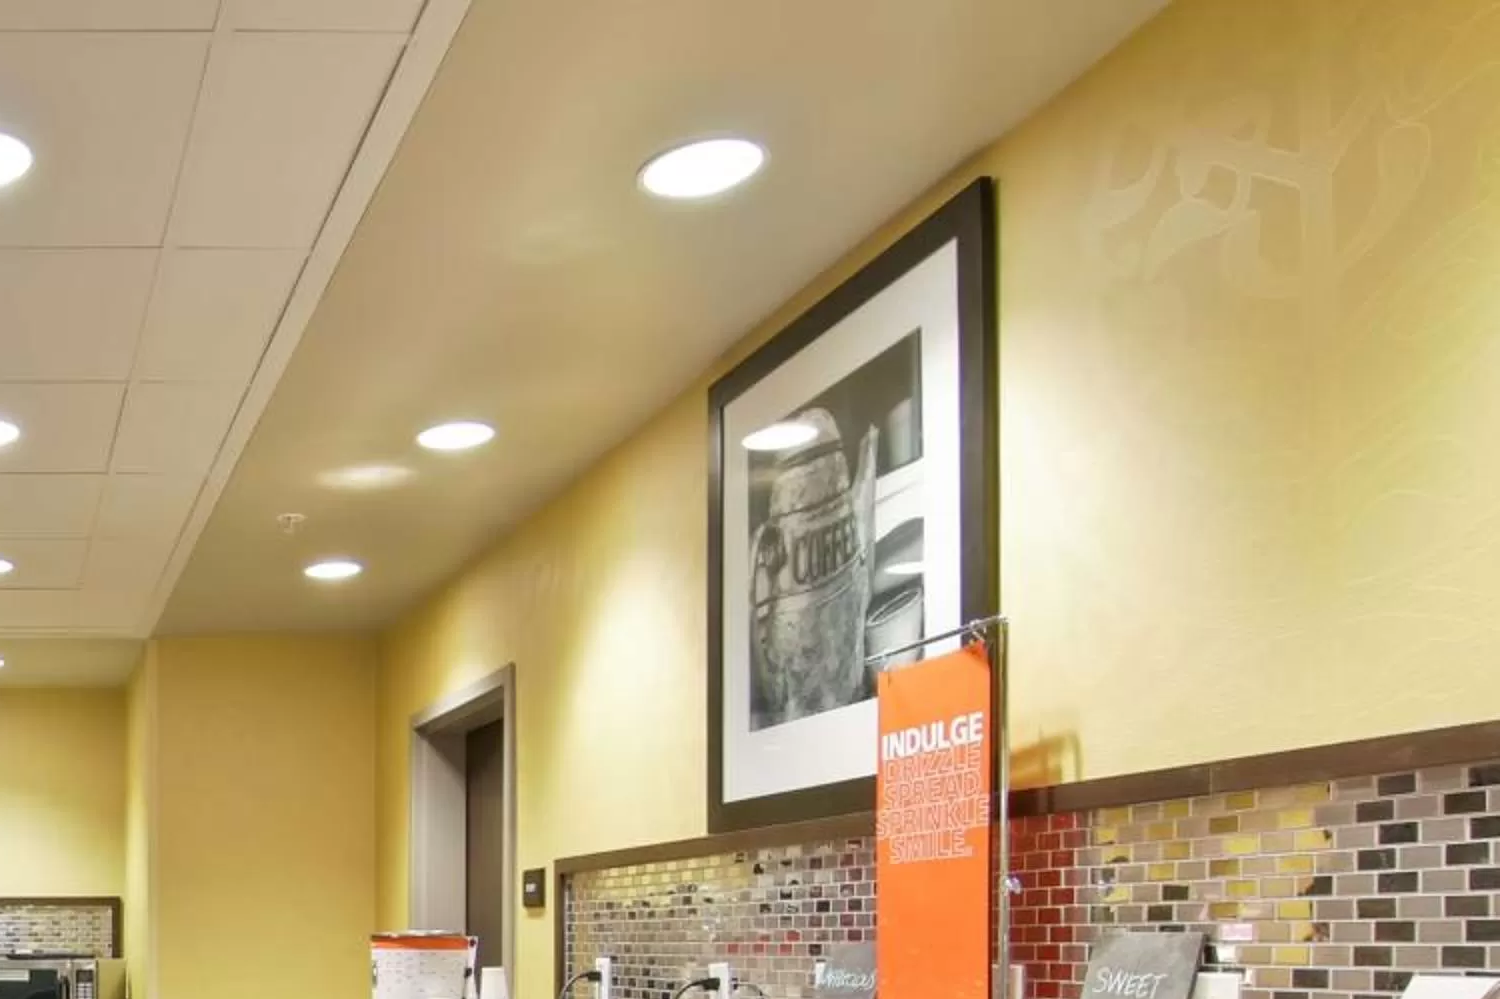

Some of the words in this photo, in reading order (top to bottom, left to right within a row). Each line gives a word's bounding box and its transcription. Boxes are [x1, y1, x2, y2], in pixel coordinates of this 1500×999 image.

[881, 712, 984, 761] INDULGE
[884, 770, 981, 810] SPREAD
[876, 795, 990, 840] SPRINKLE
[1092, 966, 1169, 999] SWEET
